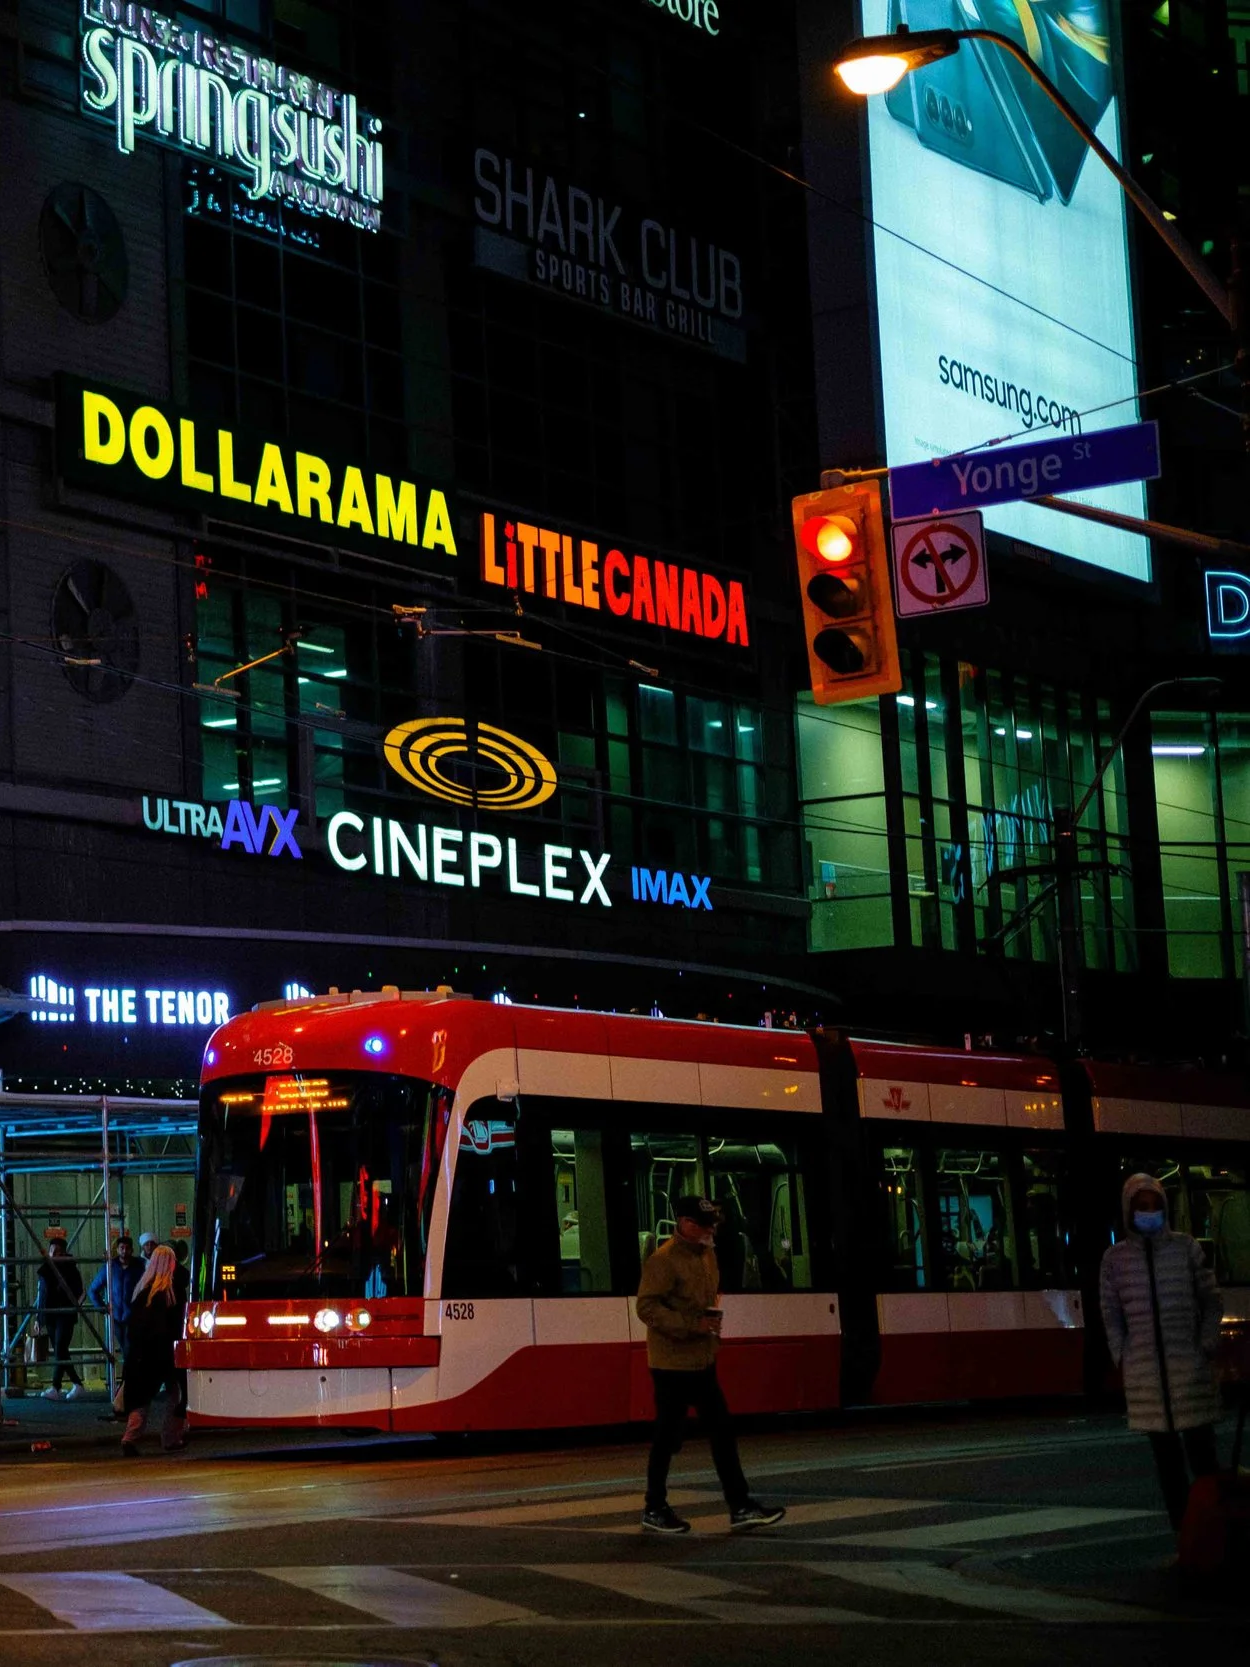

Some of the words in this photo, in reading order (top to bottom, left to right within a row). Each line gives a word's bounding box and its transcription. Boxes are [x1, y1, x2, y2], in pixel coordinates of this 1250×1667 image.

[474, 148, 626, 276] SHARK
[641, 218, 744, 320] CLUB
[535, 248, 611, 305] SPORTS
[620, 281, 658, 323] BAR
[665, 300, 716, 345] GRILL
[938, 355, 1082, 437] samsung.com
[83, 390, 458, 556] DOLLARAMA
[951, 452, 1063, 496] Yonge
[1072, 441, 1092, 461] St
[604, 549, 749, 647] CANADA
[327, 811, 612, 907] CINEPLEX
[631, 866, 713, 911] IMAX
[84, 988, 137, 1023] THE
[145, 990, 230, 1024] TENOR
[254, 1047, 294, 1065] 4528
[445, 1302, 475, 1320] 4528
